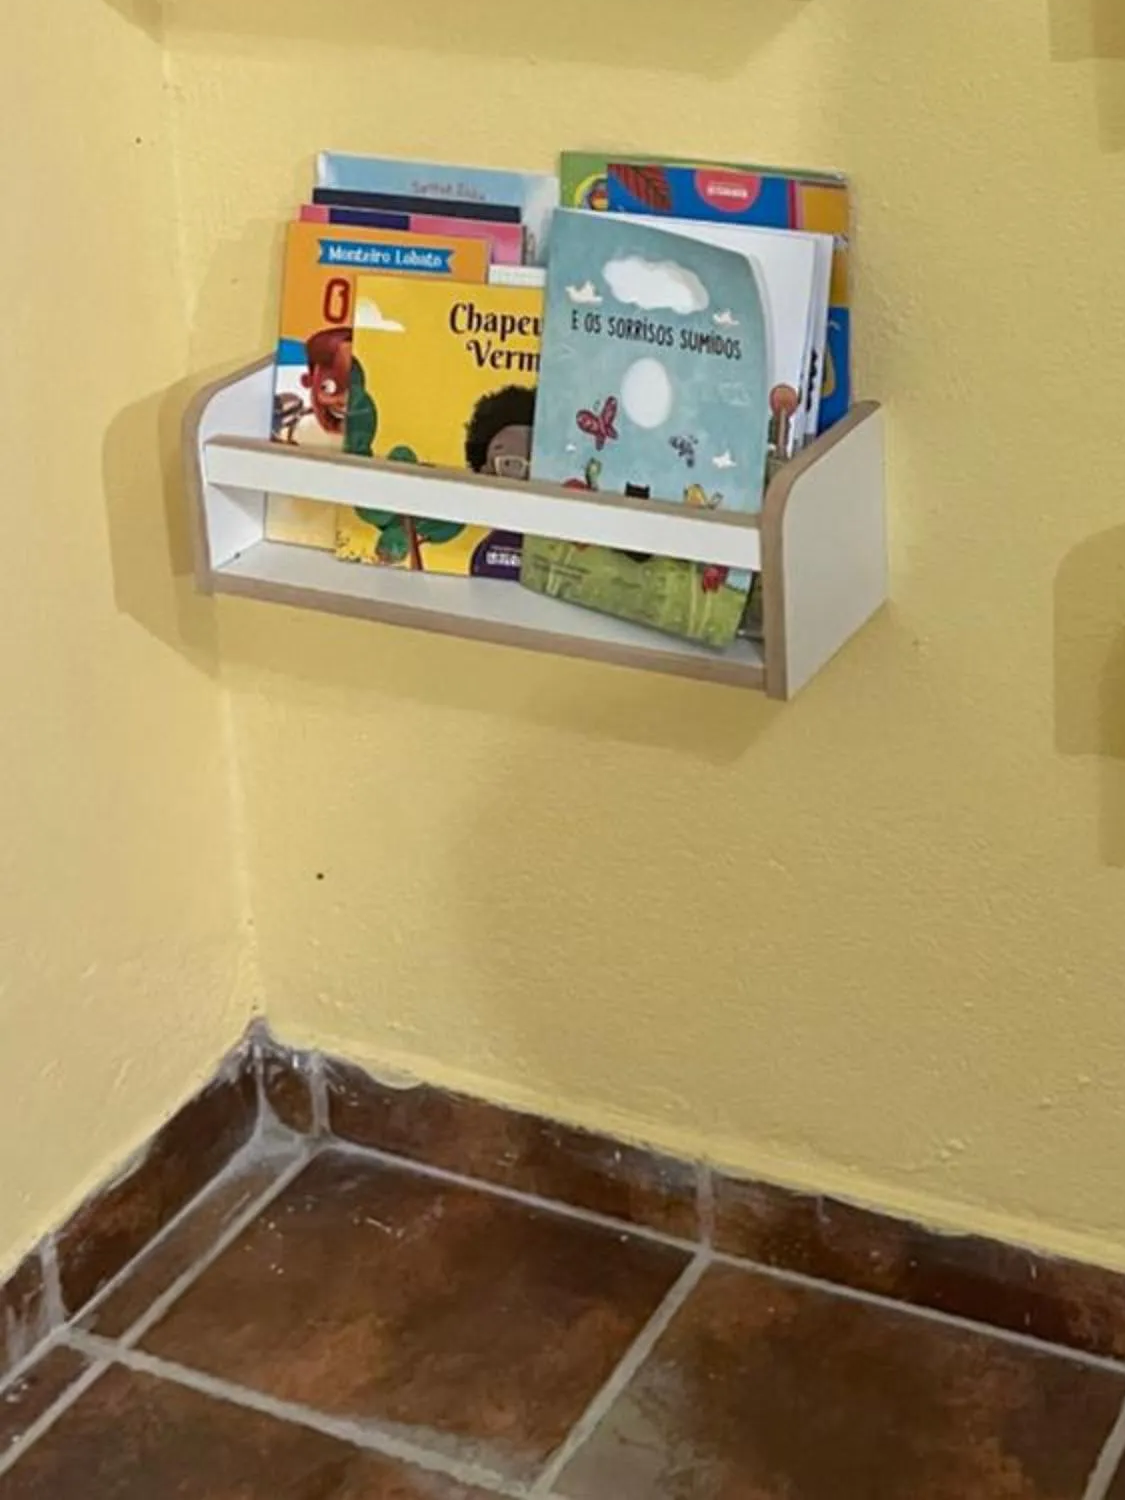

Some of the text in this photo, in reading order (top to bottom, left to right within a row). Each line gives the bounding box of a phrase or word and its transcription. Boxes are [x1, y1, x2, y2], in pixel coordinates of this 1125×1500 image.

[328, 245, 443, 269] Monteiro Lobato
[571, 310, 579, 331] E
[584, 312, 602, 335] OS
